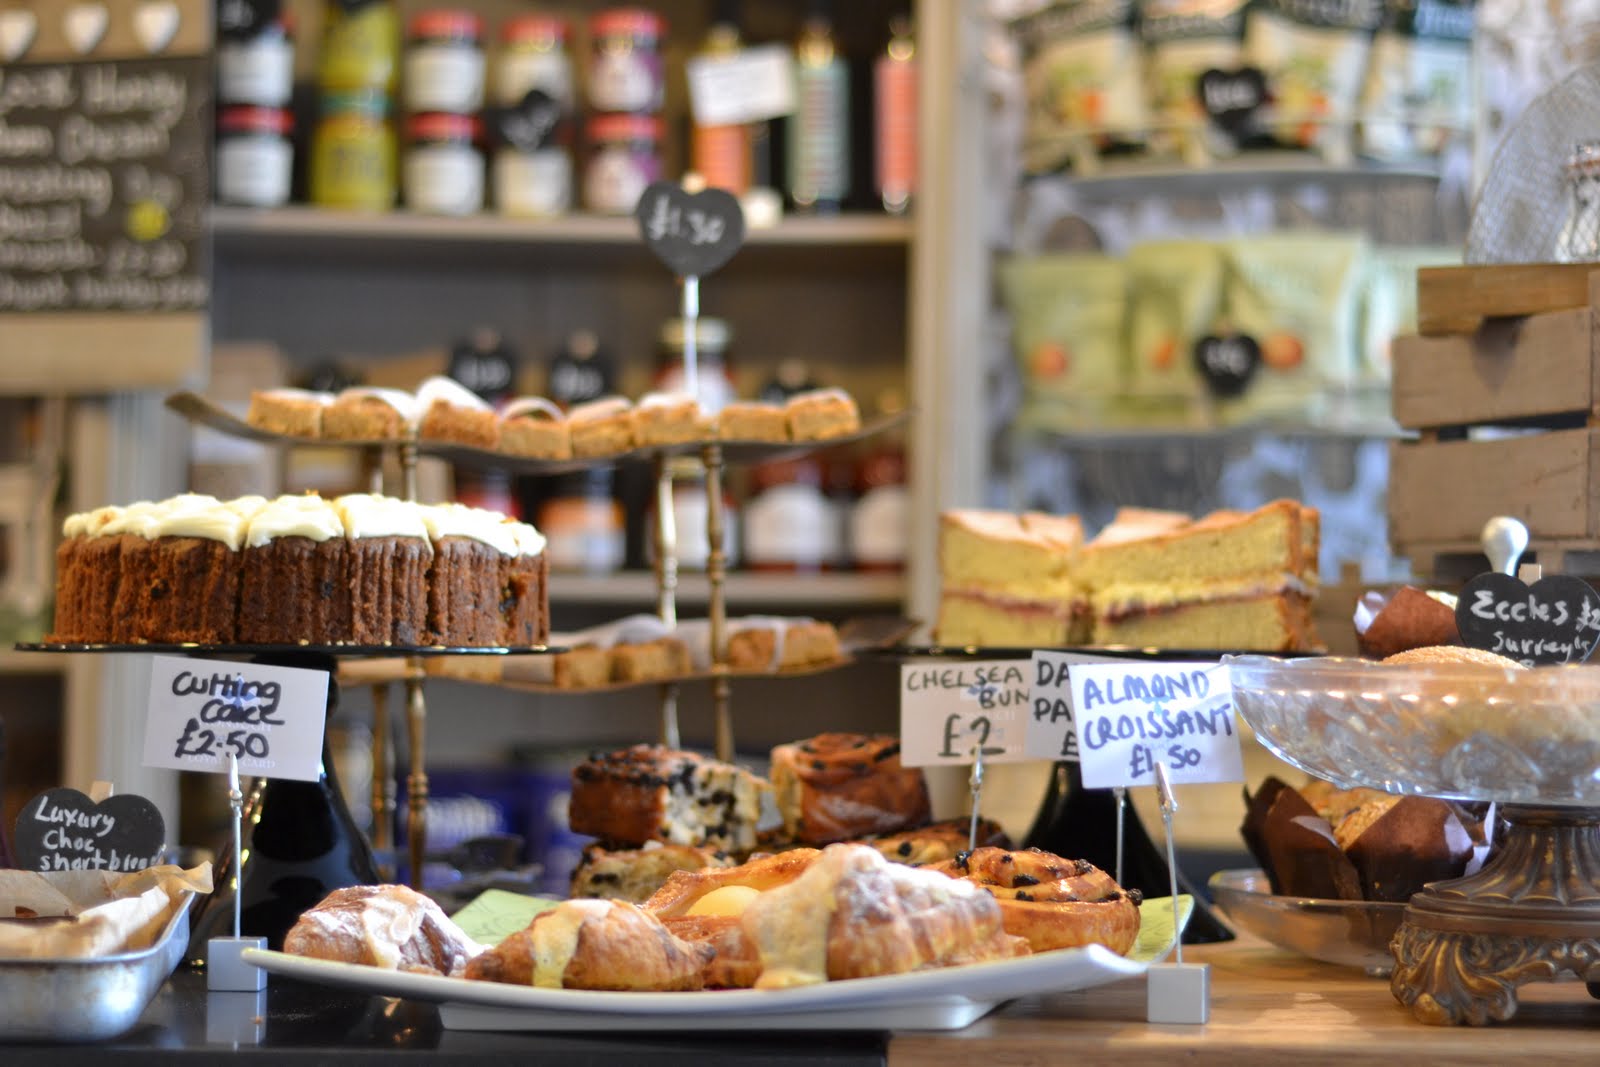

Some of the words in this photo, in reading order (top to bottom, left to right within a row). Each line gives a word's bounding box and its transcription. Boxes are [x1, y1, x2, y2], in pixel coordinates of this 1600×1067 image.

[1470, 589, 1569, 626] Eccles
[172, 671, 282, 713] Cutting
[906, 665, 1024, 691] CHELSEA
[979, 687, 1031, 710] BUN
[1084, 669, 1210, 710] ALMOND
[175, 717, 270, 759] £2.50
[937, 713, 1007, 758] £2
[1084, 702, 1234, 751] CROISSANT
[34, 795, 116, 837] Luxury
